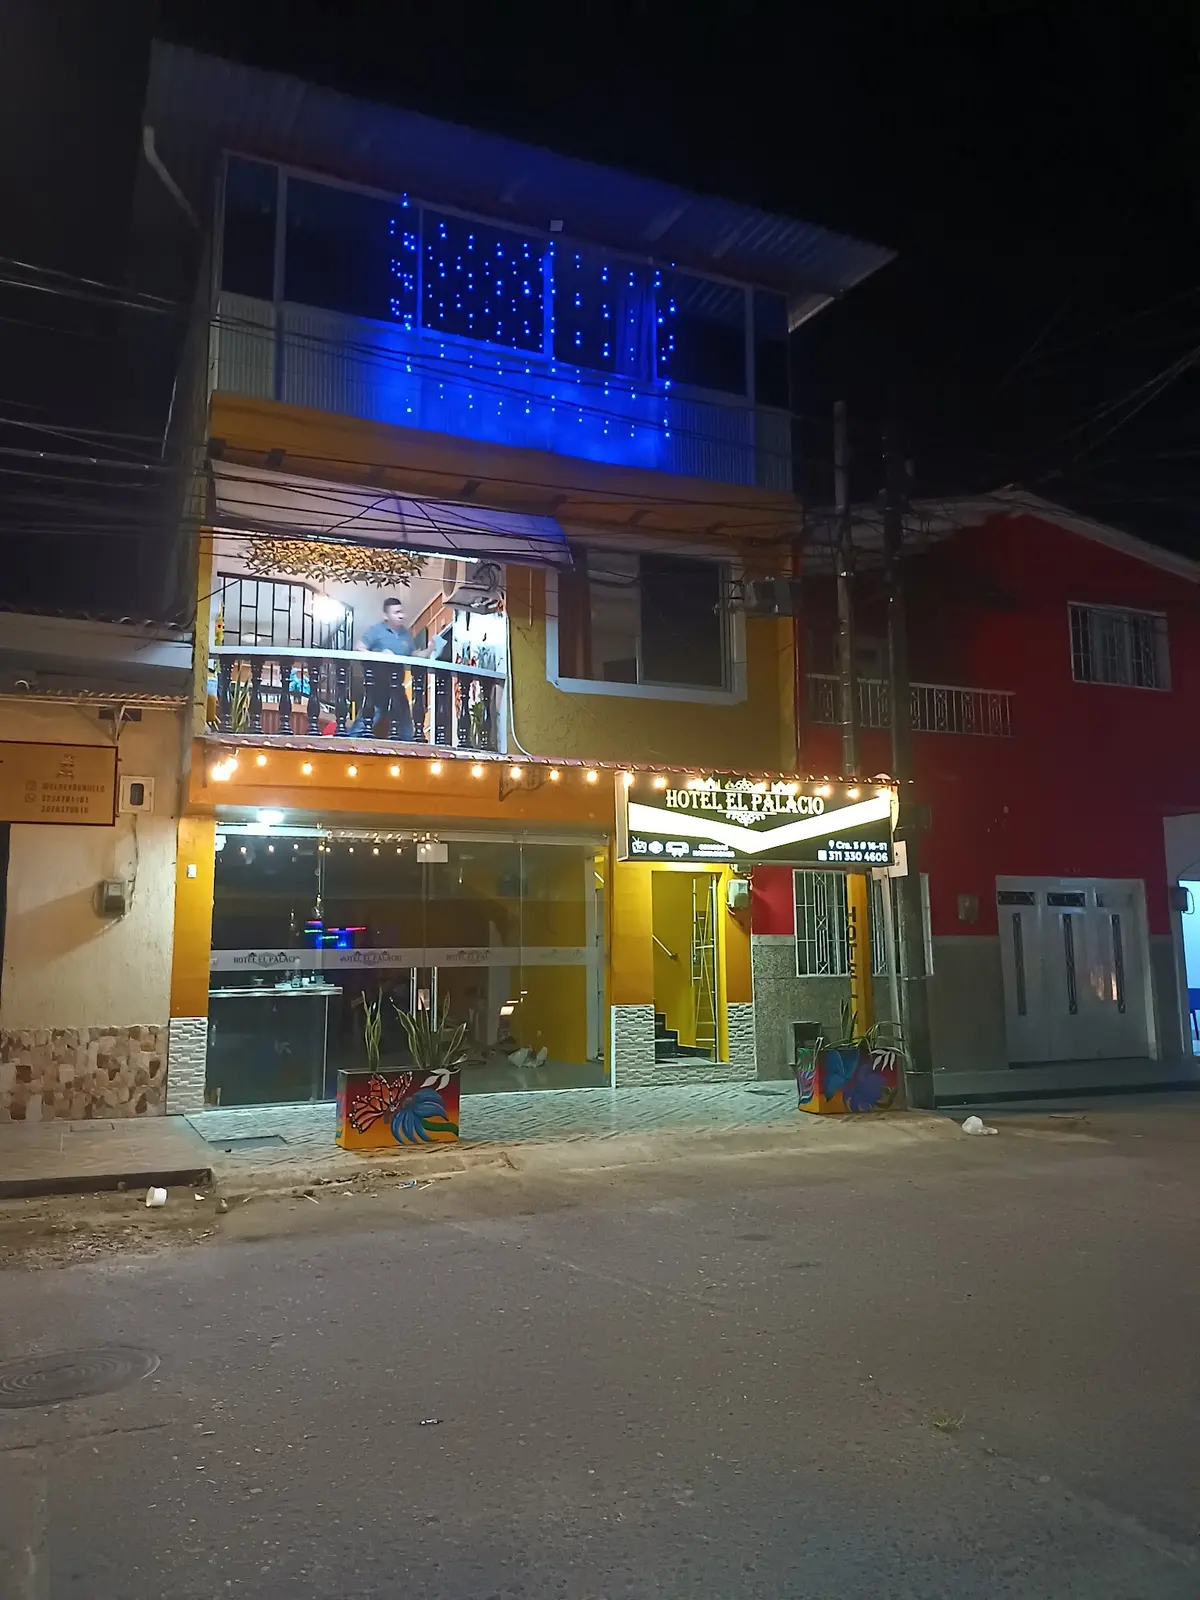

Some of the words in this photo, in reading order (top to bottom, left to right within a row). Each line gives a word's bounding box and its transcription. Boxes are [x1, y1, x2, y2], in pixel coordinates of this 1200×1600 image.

[666, 789, 722, 810] HOTEL
[726, 792, 748, 811] EL
[751, 793, 824, 815] PALACIO
[828, 850, 842, 861] 311
[844, 851, 862, 862] 330
[864, 851, 888, 863] 4606
[233, 955, 255, 964] HOTEL
